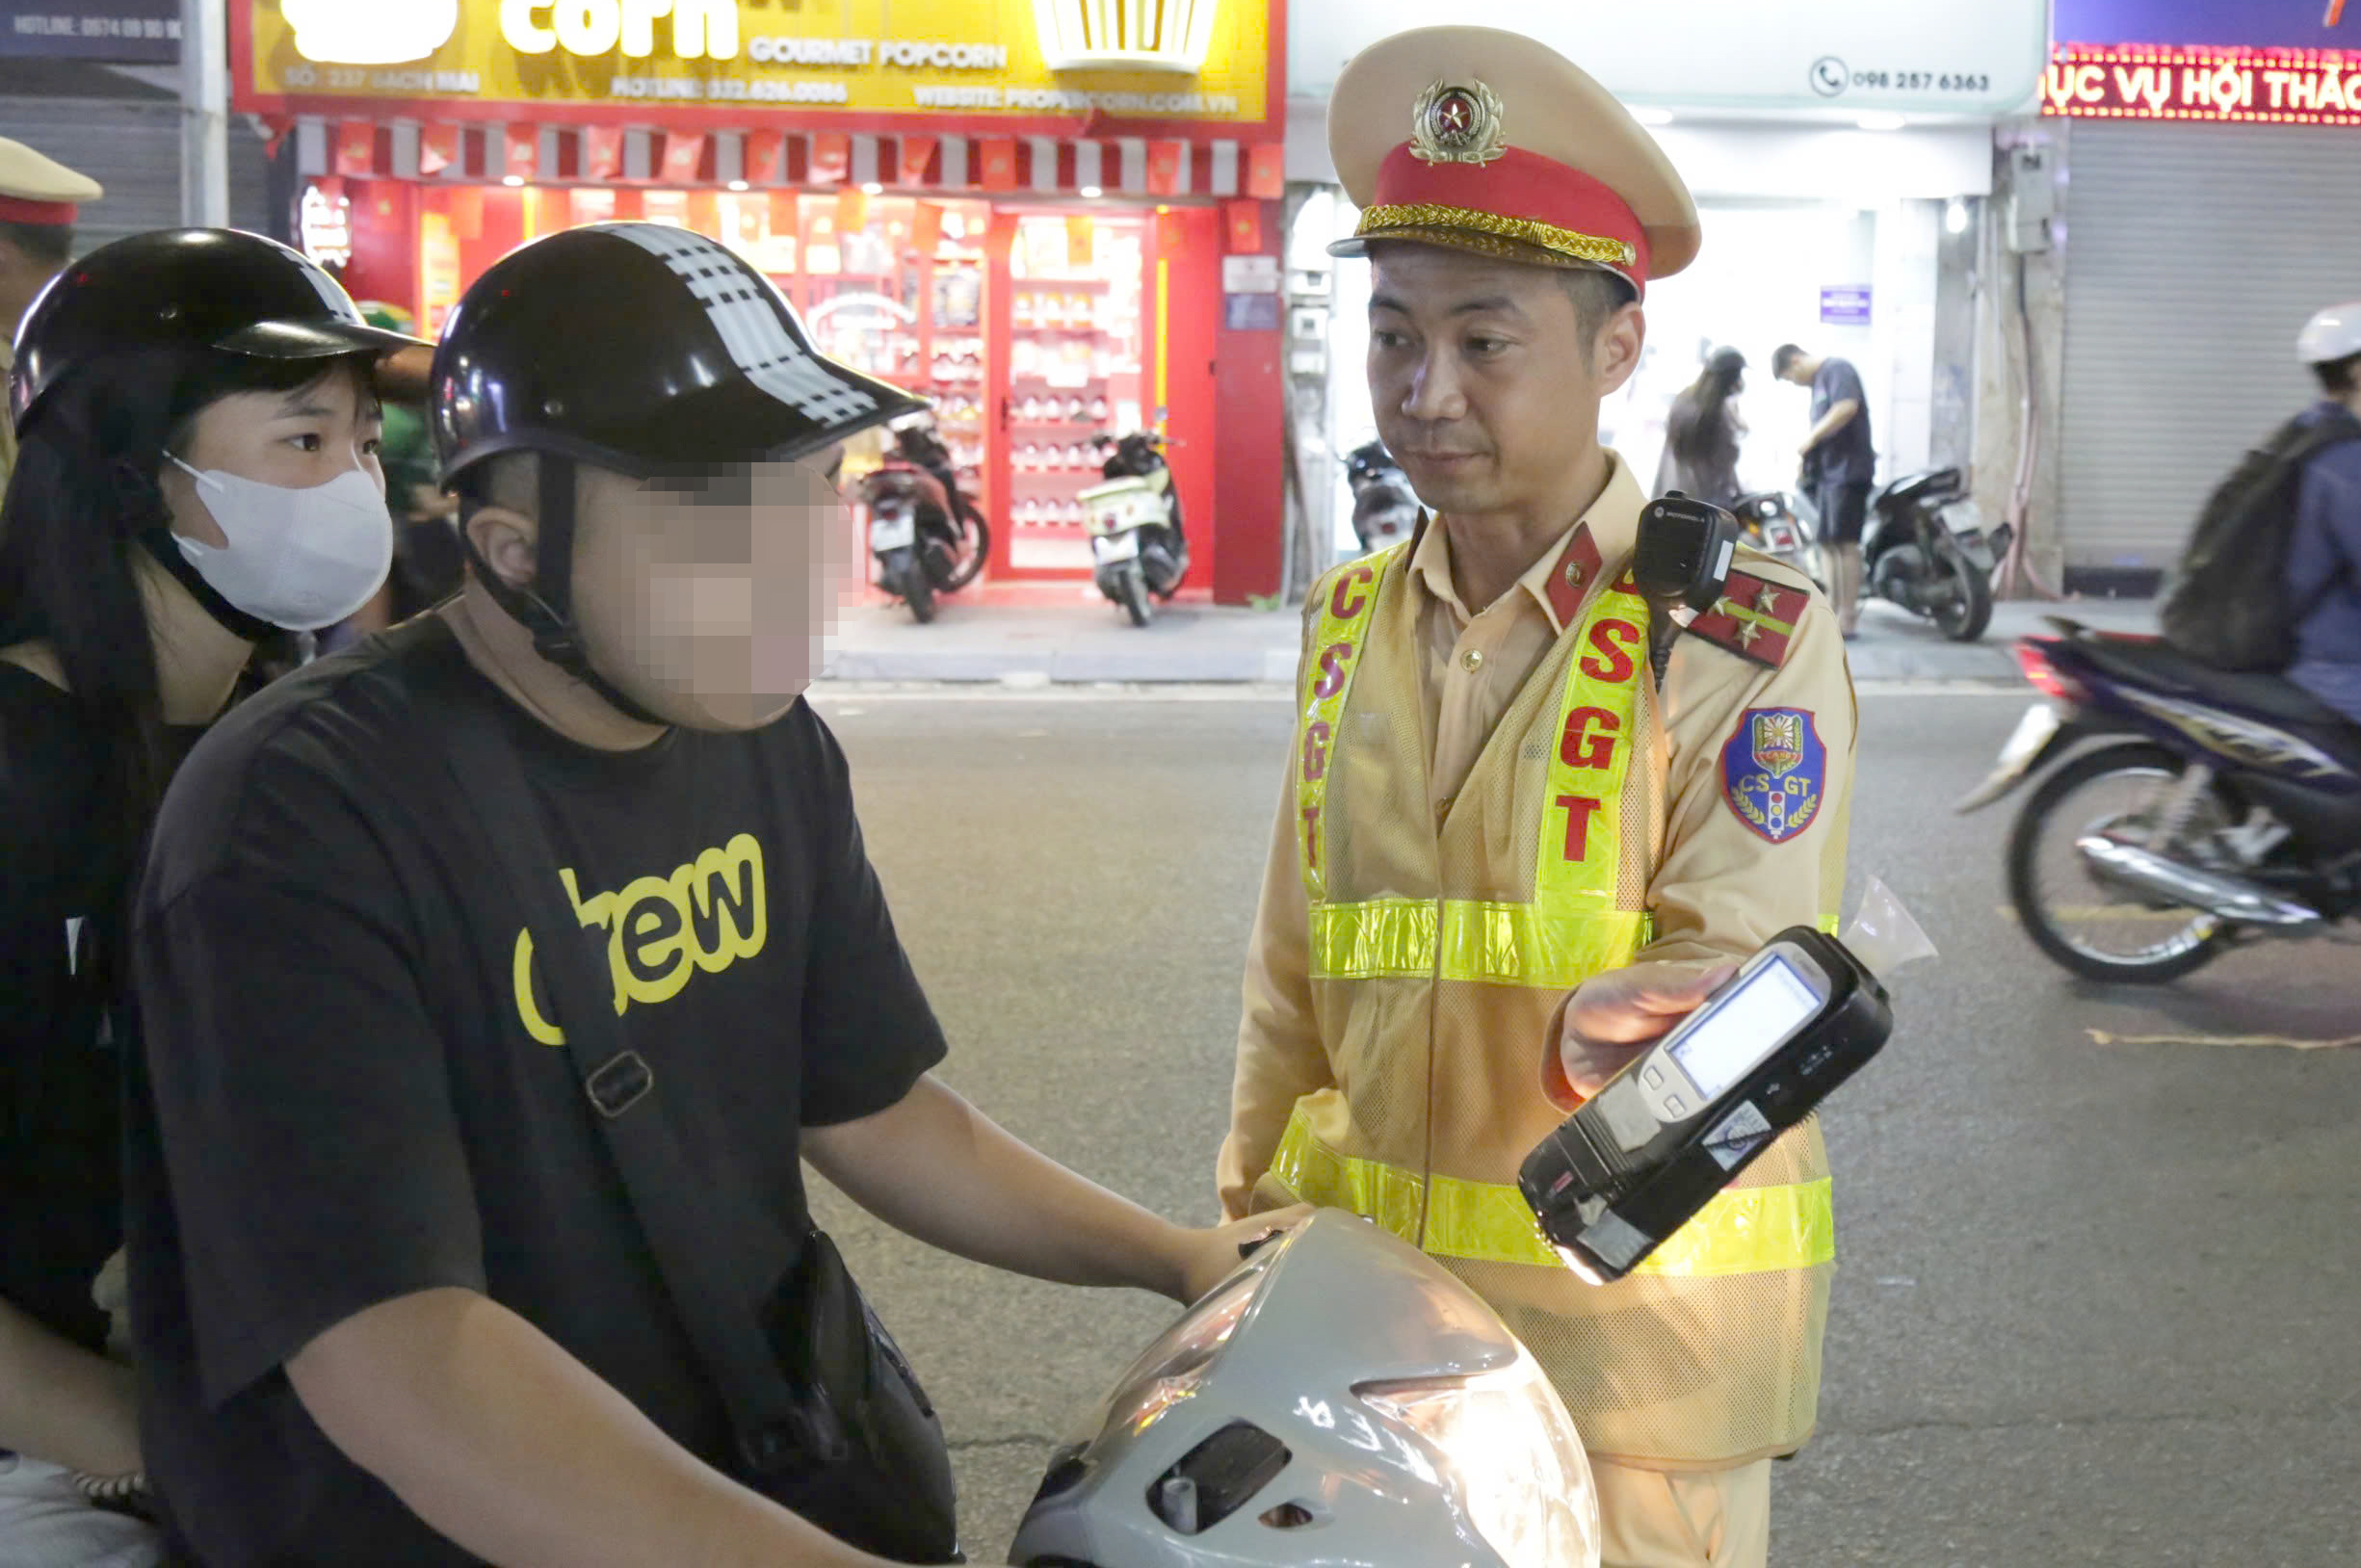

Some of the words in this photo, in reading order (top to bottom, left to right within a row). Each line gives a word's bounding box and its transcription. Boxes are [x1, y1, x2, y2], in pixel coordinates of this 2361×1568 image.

[749, 37, 871, 65] GOURMET
[879, 41, 1008, 68] POPCORN
[1852, 71, 1890, 90] 098
[1939, 73, 1990, 91] 6363
[2113, 65, 2171, 112] VỤ
[2182, 63, 2254, 113] HỘI
[1302, 565, 1374, 869] CSGT
[512, 832, 768, 1046] ew
